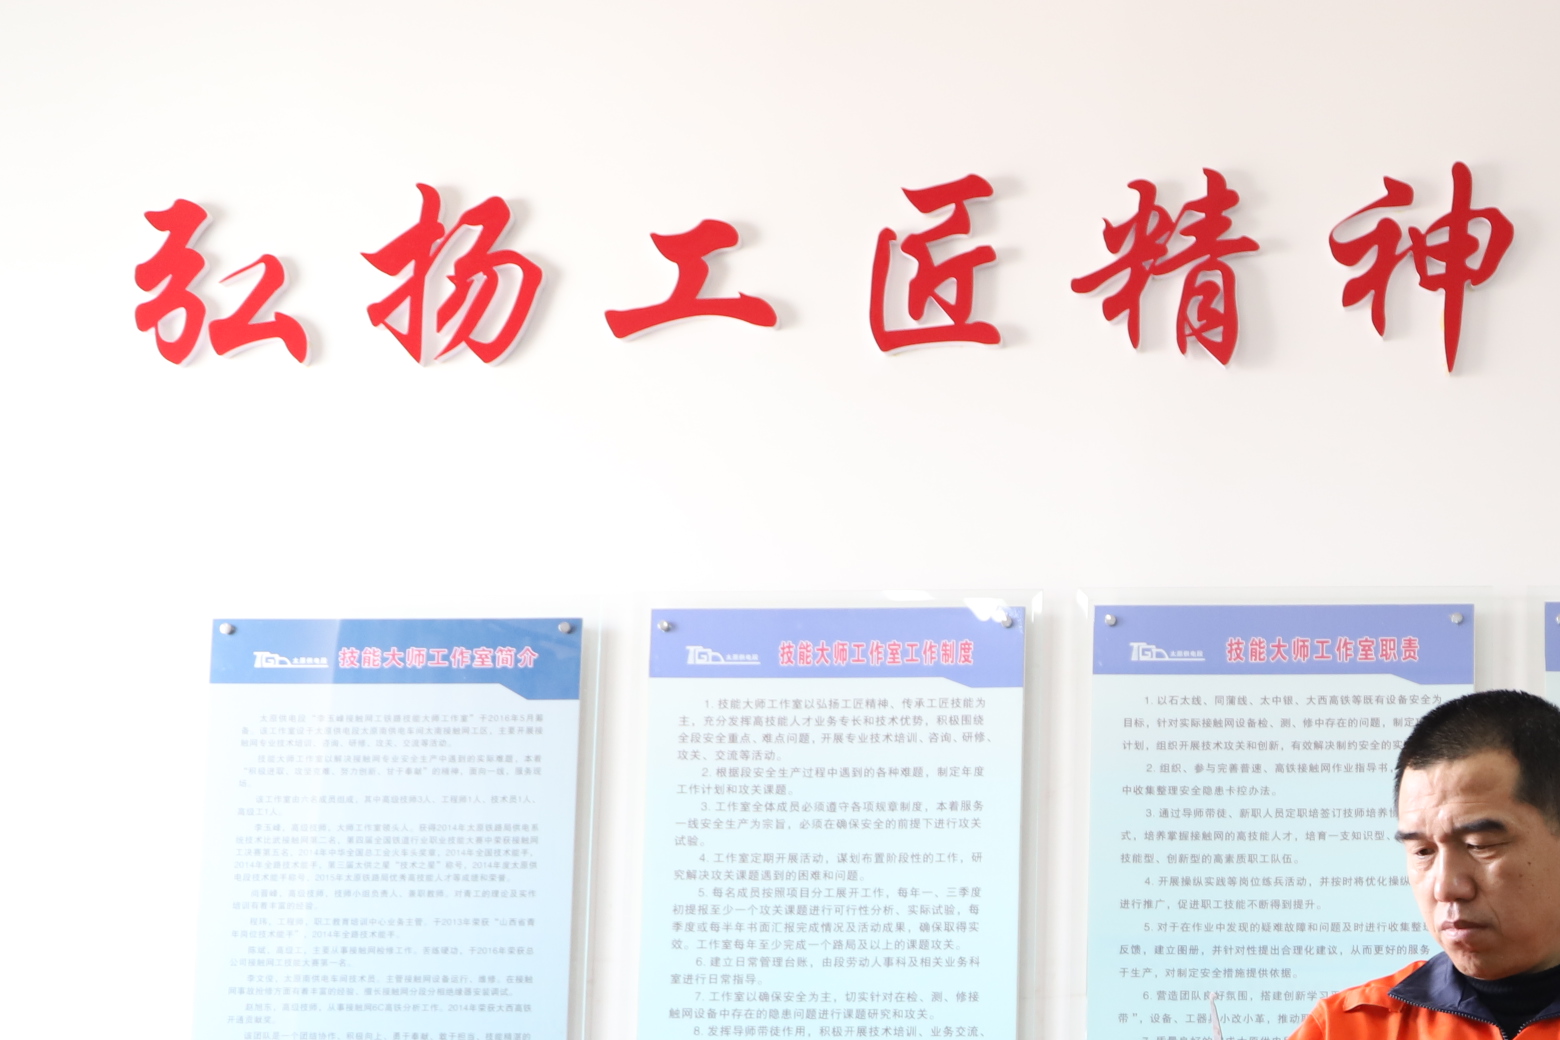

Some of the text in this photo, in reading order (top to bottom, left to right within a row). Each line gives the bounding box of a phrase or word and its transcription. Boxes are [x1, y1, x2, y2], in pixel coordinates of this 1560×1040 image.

[136, 163, 1513, 370] 弘扬工匠精神
[339, 646, 539, 670] 技能大师工作室简介
[778, 640, 974, 666] 技能大师工作室工作制度
[1225, 637, 1420, 663] 技能大师工作室职责
[674, 834, 705, 847] 试验。
